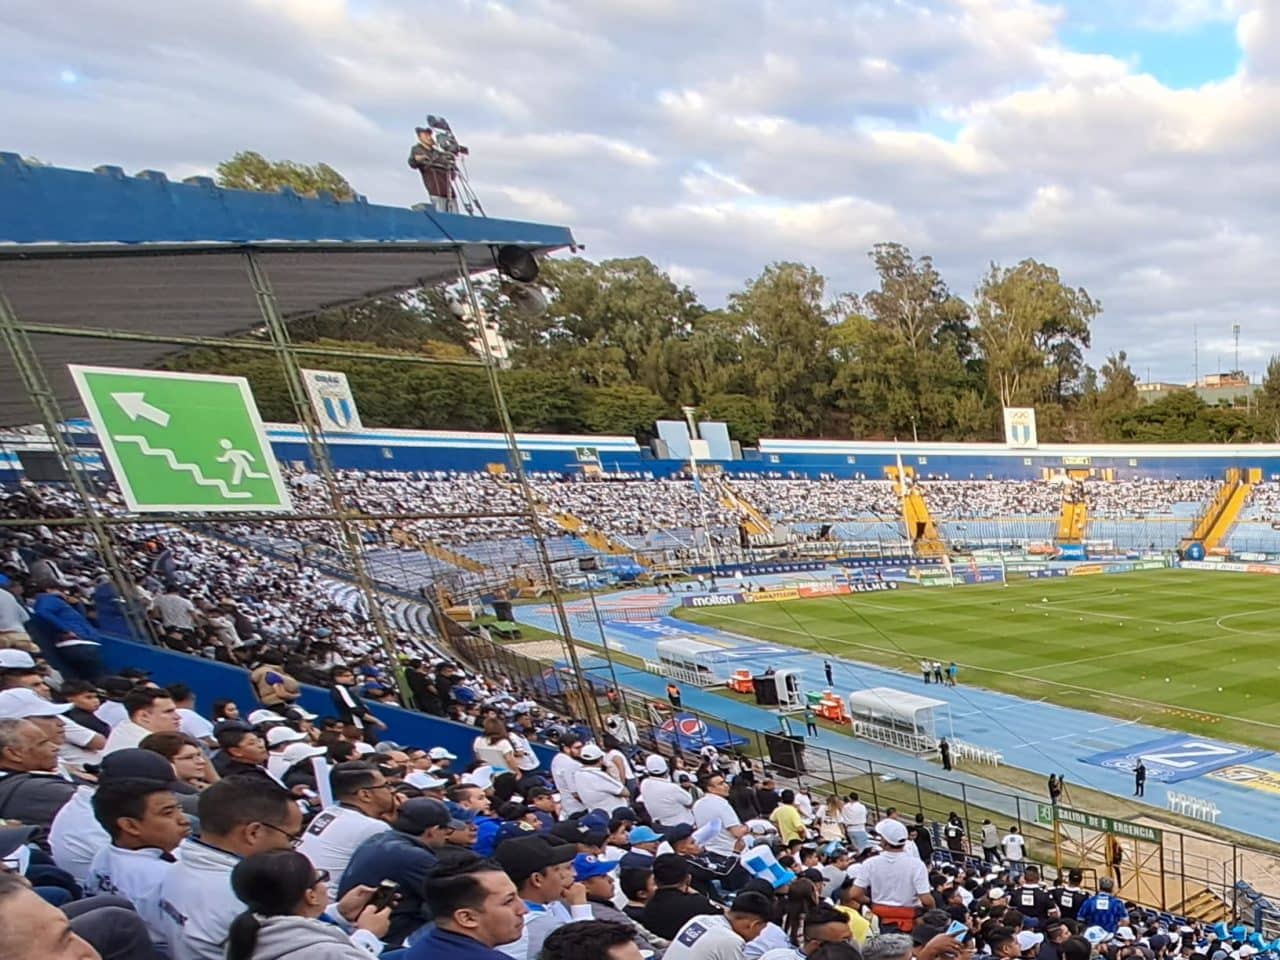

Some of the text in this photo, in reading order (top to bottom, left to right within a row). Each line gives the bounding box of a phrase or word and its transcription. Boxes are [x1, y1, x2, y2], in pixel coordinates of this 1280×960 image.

[849, 581, 887, 592] KELME
[692, 594, 736, 606] molten
[1058, 808, 1154, 838] SALIDA DE EERGENCIA
